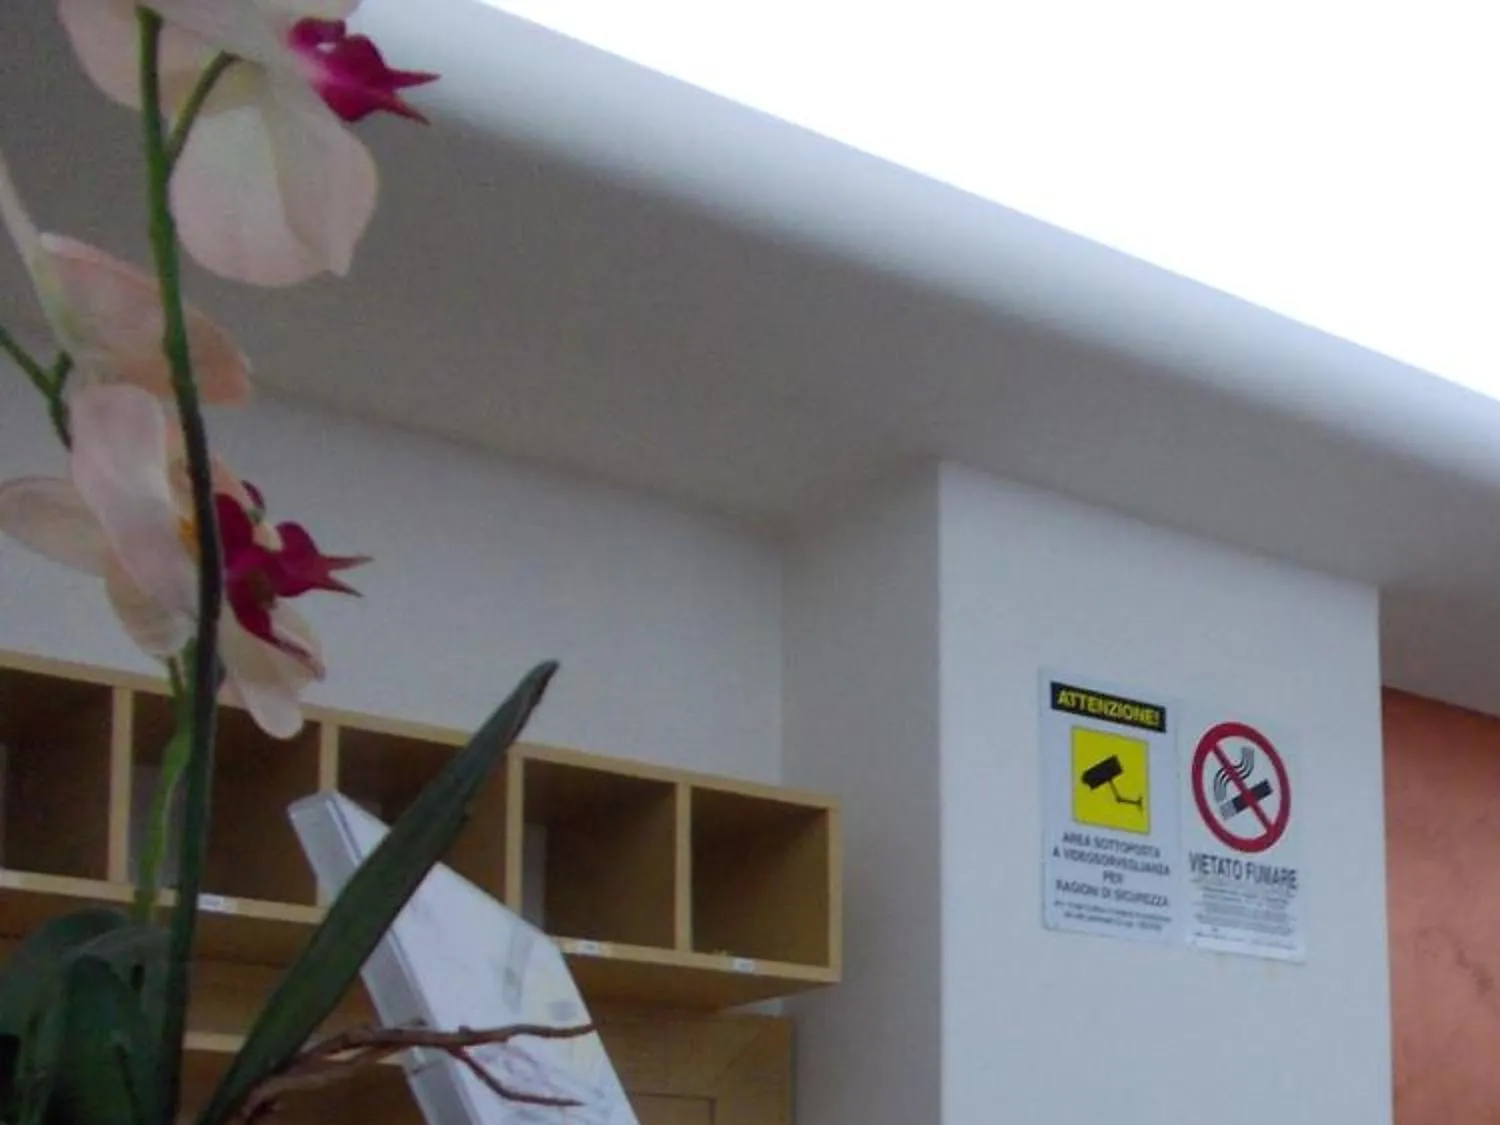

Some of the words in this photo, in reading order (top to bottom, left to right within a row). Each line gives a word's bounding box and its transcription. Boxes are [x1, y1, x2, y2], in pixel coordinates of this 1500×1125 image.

[1057, 689, 1160, 726] ATTENZIONE!
[1062, 832, 1090, 847] AREA
[1053, 845, 1061, 858] A
[1103, 870, 1123, 885] PER
[1188, 852, 1243, 881] VIETATO
[1245, 861, 1297, 890] FUMARE
[1056, 880, 1099, 897] RAGIONI
